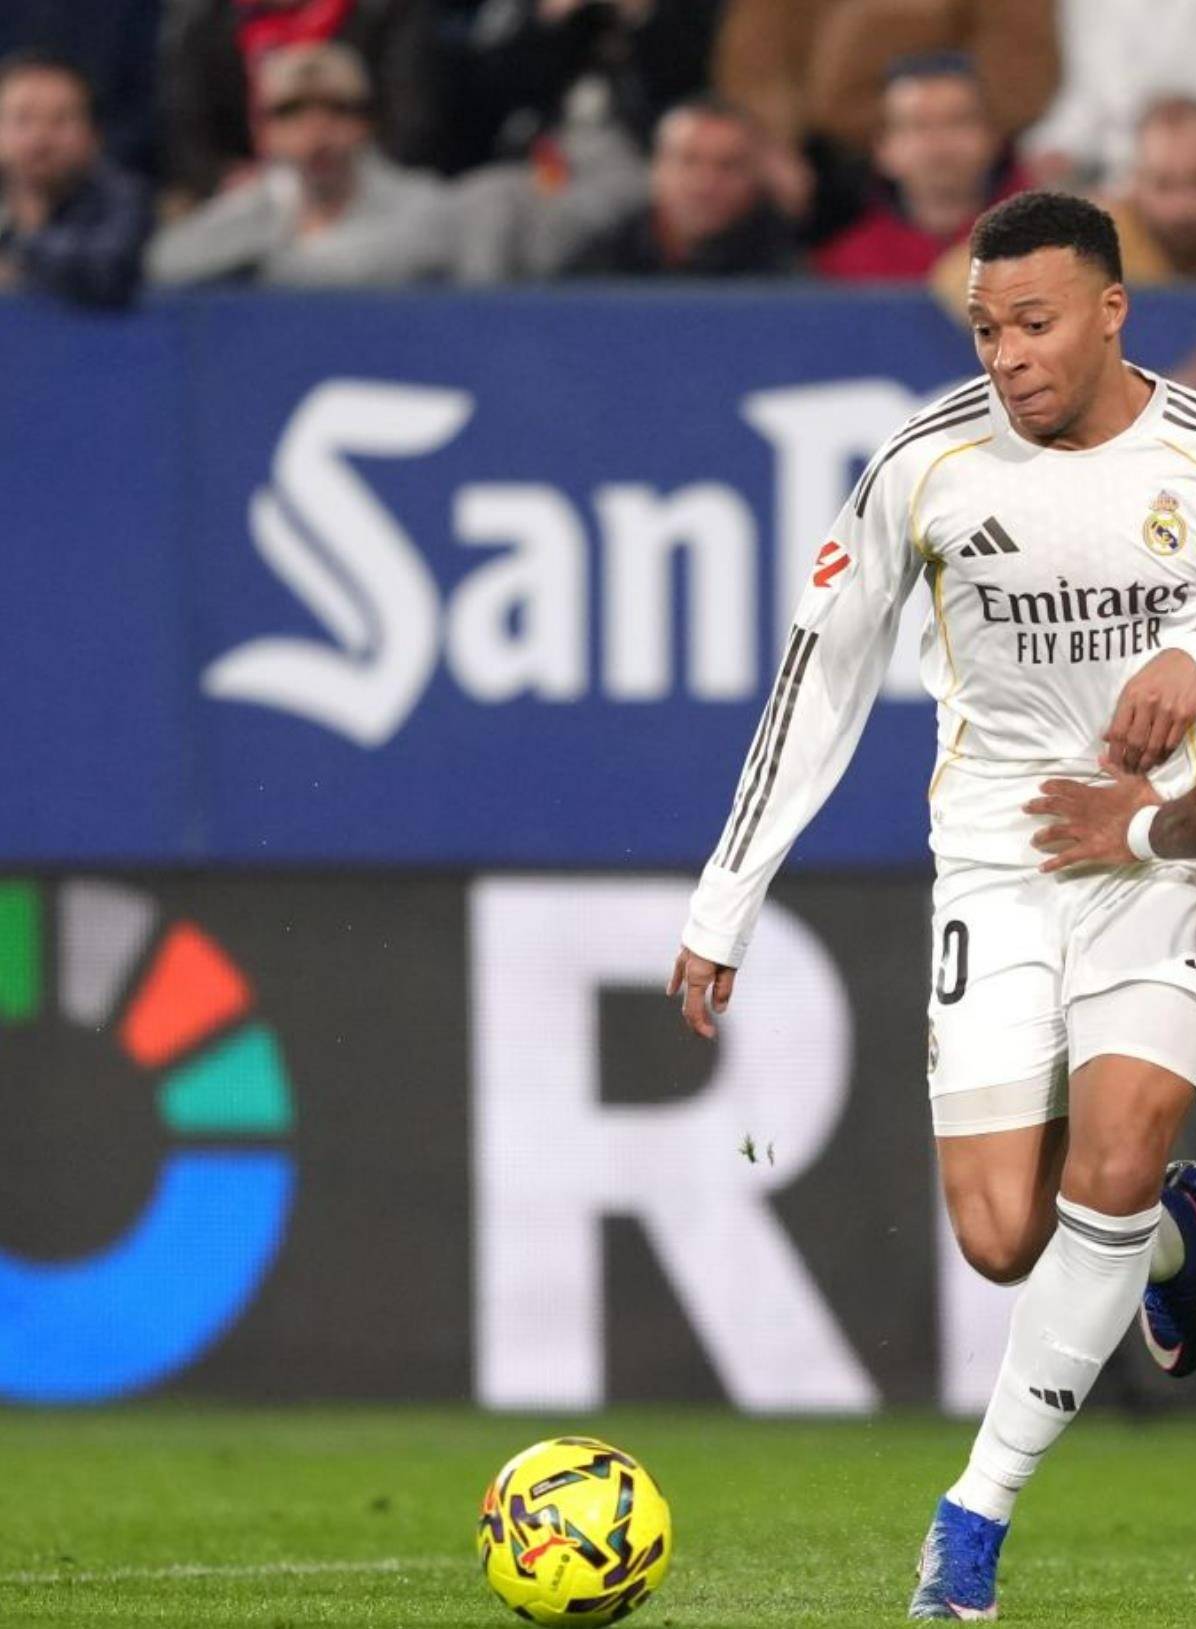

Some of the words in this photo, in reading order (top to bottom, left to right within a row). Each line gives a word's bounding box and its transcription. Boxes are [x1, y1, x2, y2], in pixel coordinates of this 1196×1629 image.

[202, 377, 760, 748] San
[974, 577, 1190, 625] Emirates
[1016, 632, 1058, 664] FLY
[1069, 617, 1163, 664] BETTER
